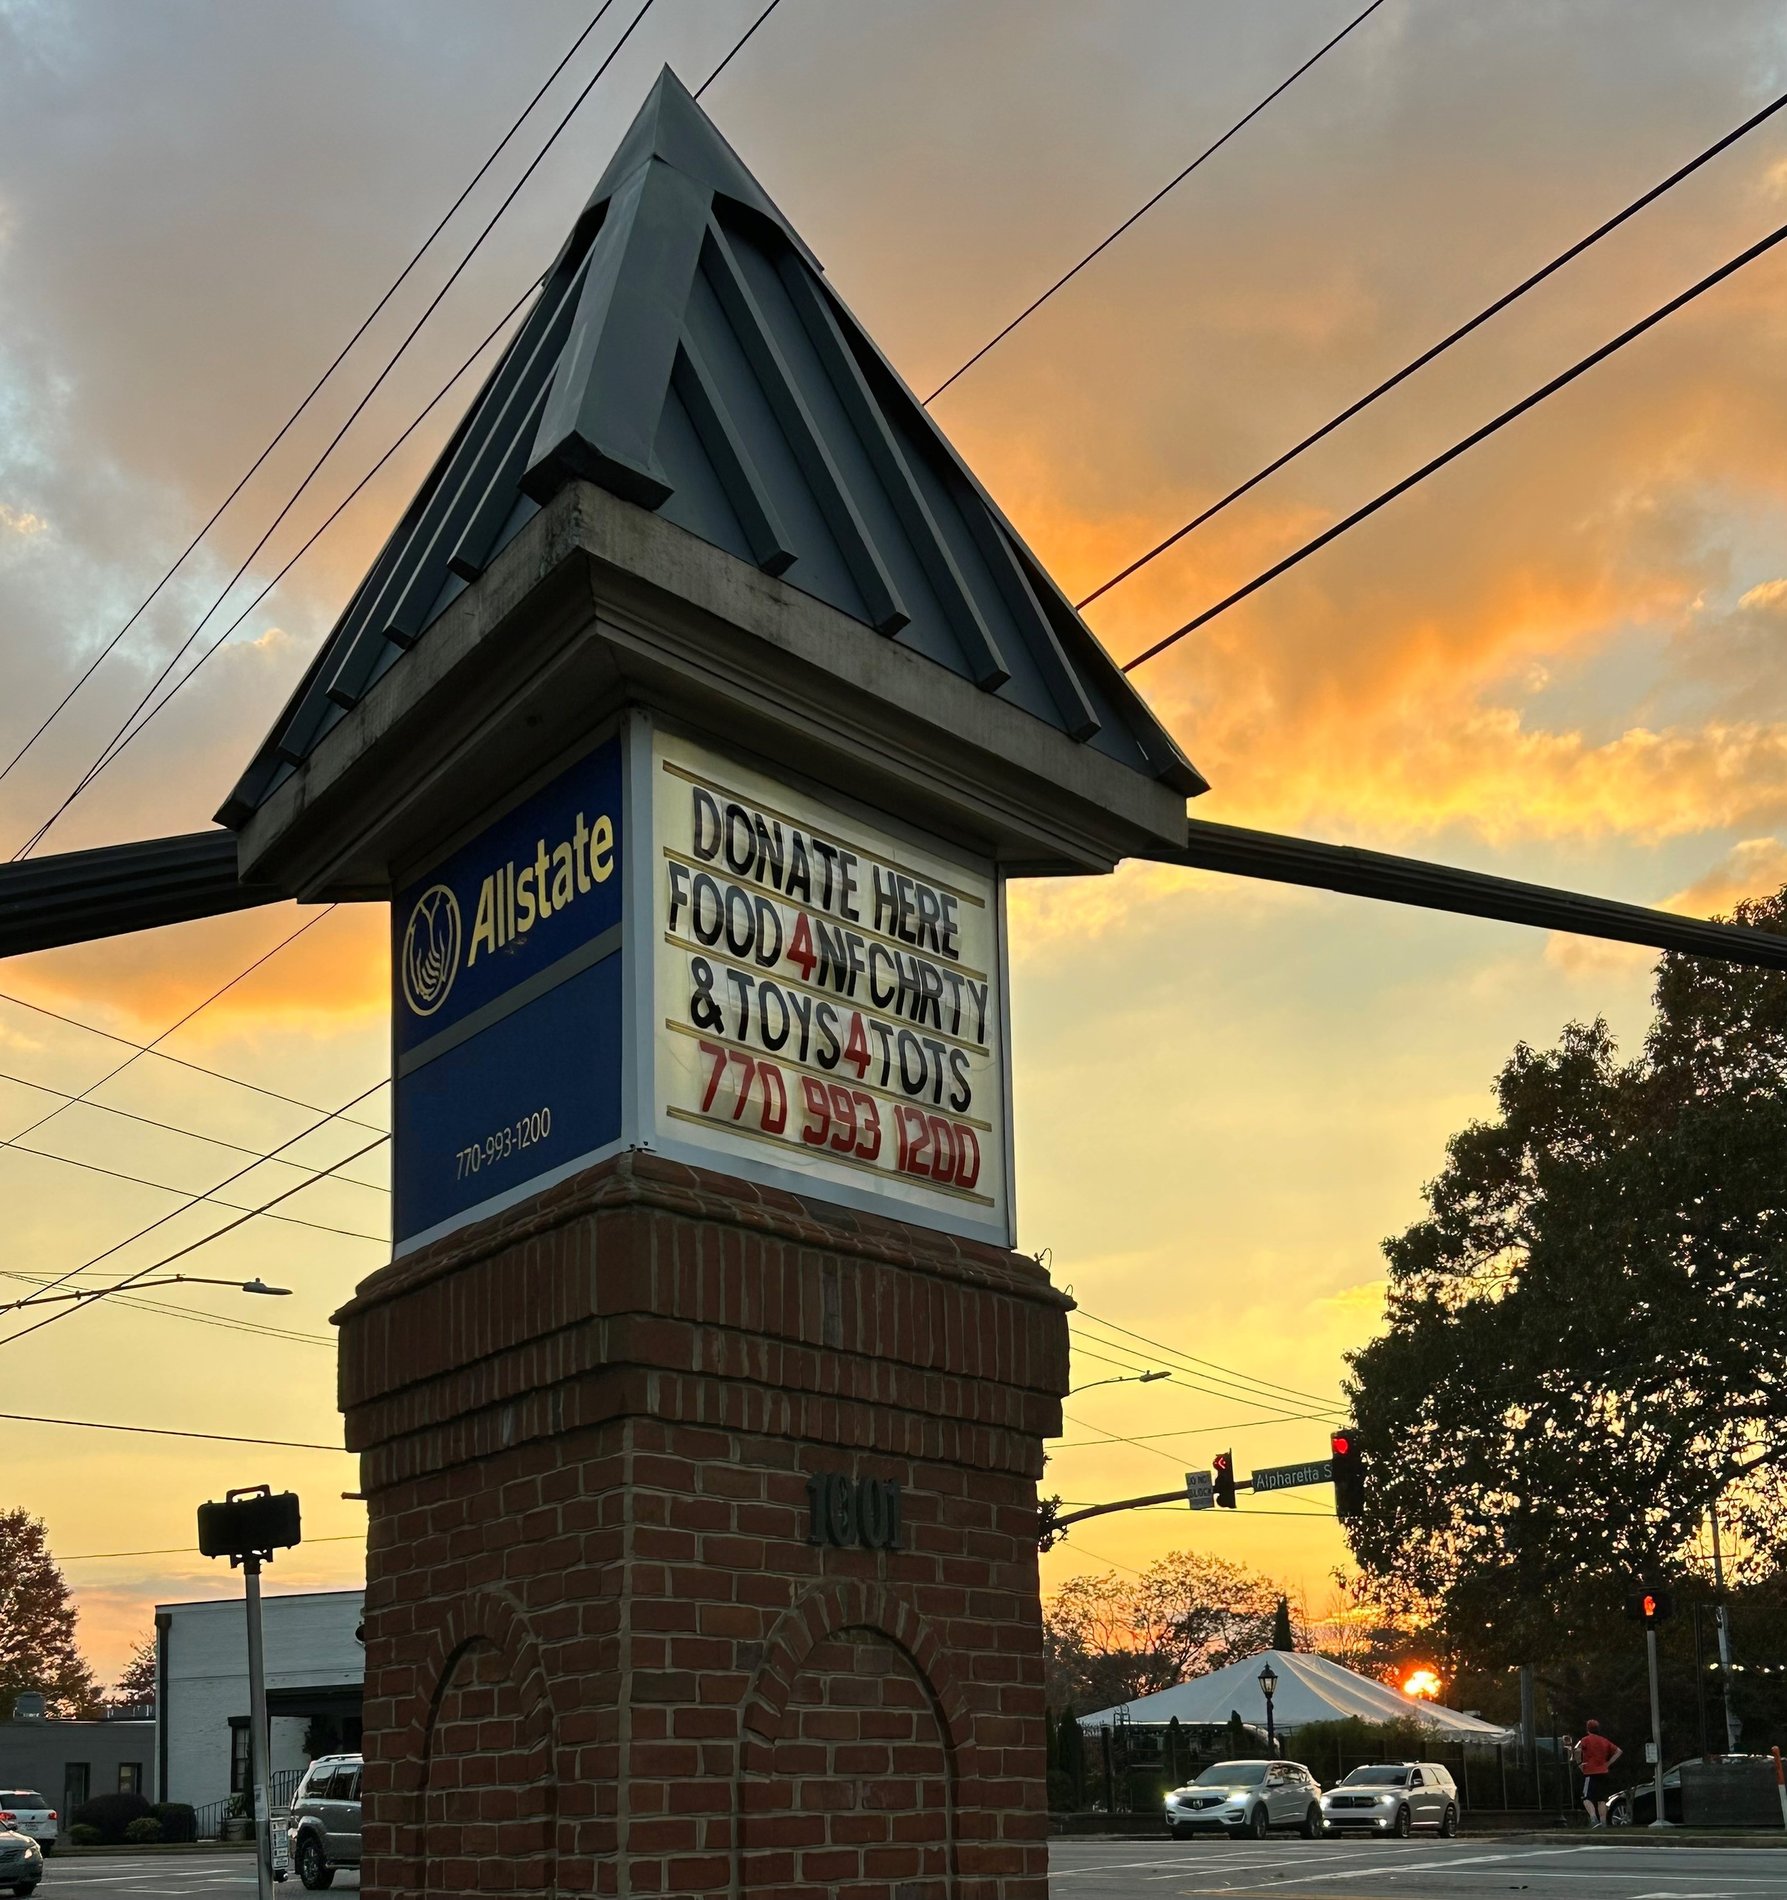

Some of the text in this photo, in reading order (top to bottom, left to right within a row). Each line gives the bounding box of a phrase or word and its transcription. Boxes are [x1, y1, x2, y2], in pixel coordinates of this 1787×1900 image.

[467, 812, 614, 967] Allstate
[693, 787, 959, 960] DONATE HERE
[455, 1107, 552, 1180] 770-993-1200
[700, 1041, 980, 1189] 770 993 1200
[1256, 1466, 1320, 1489] Alpharetta
